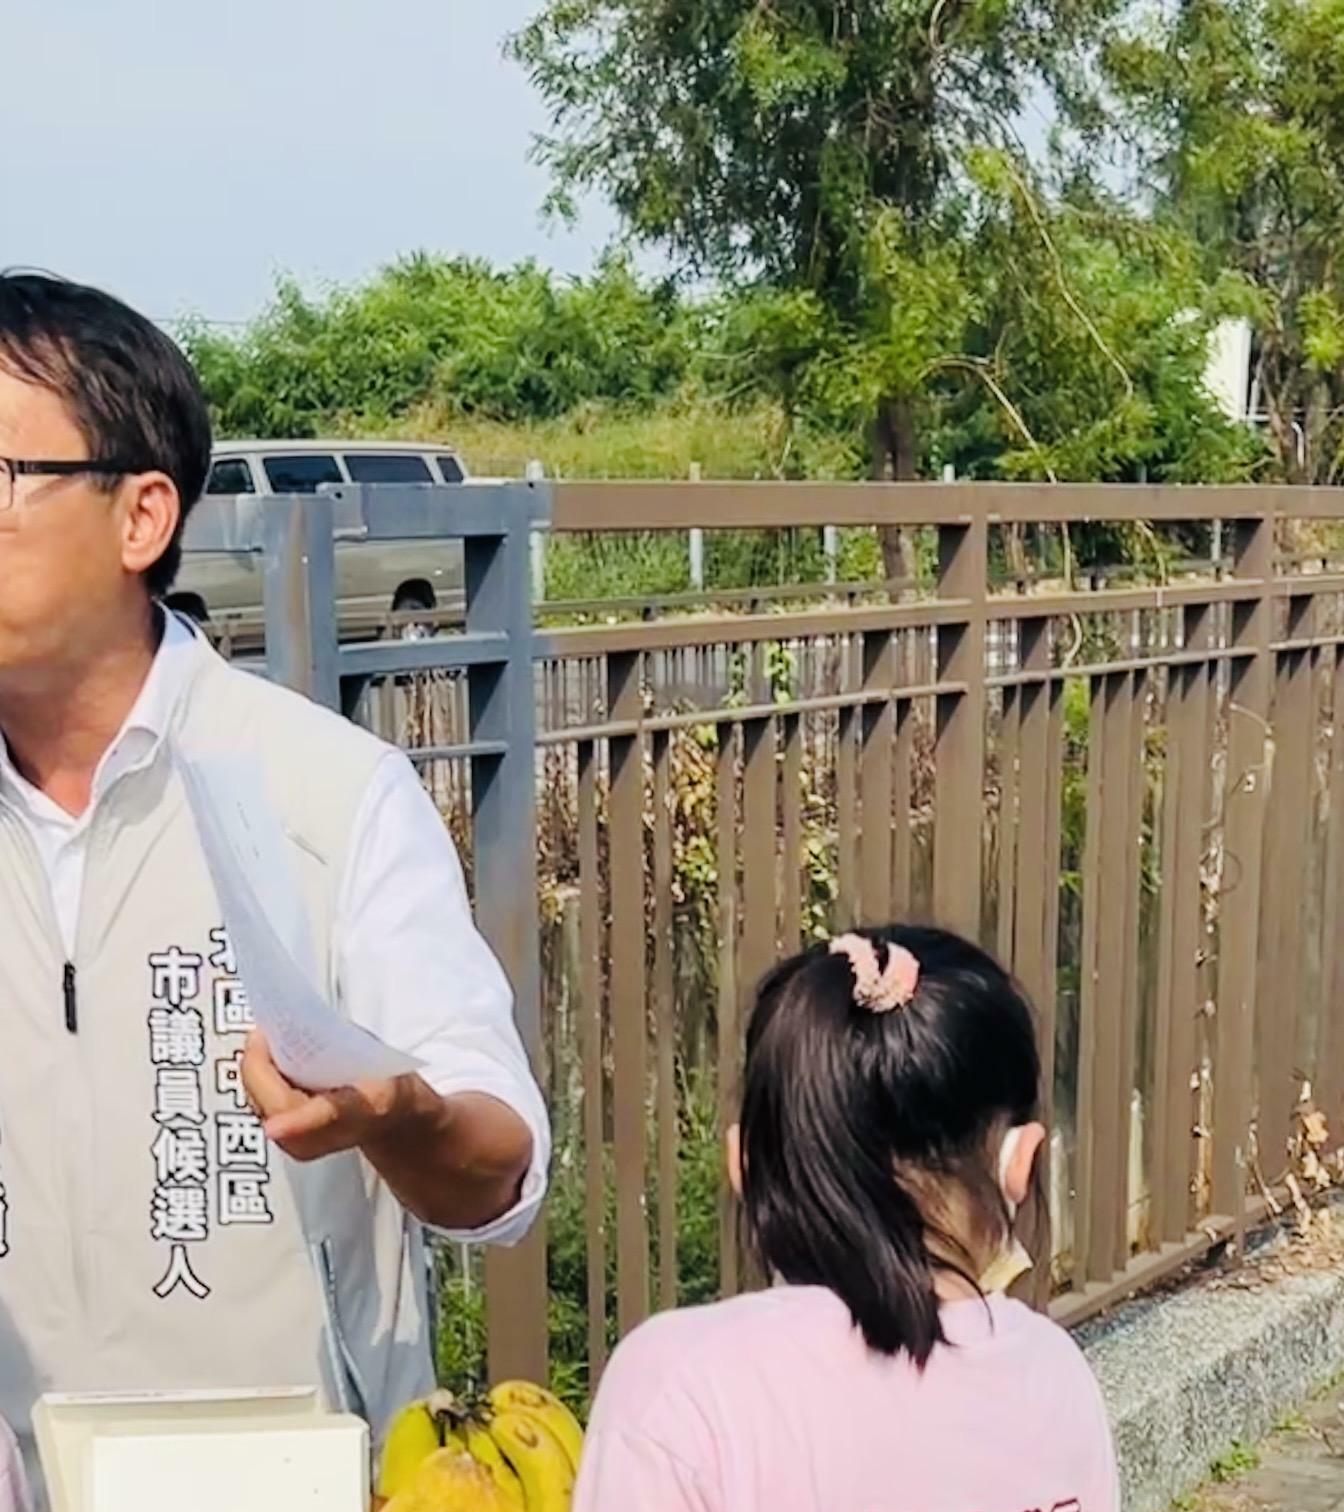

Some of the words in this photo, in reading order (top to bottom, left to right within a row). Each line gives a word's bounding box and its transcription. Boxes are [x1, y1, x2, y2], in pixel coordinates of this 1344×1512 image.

[147, 946, 211, 1300] 市議員候選人
